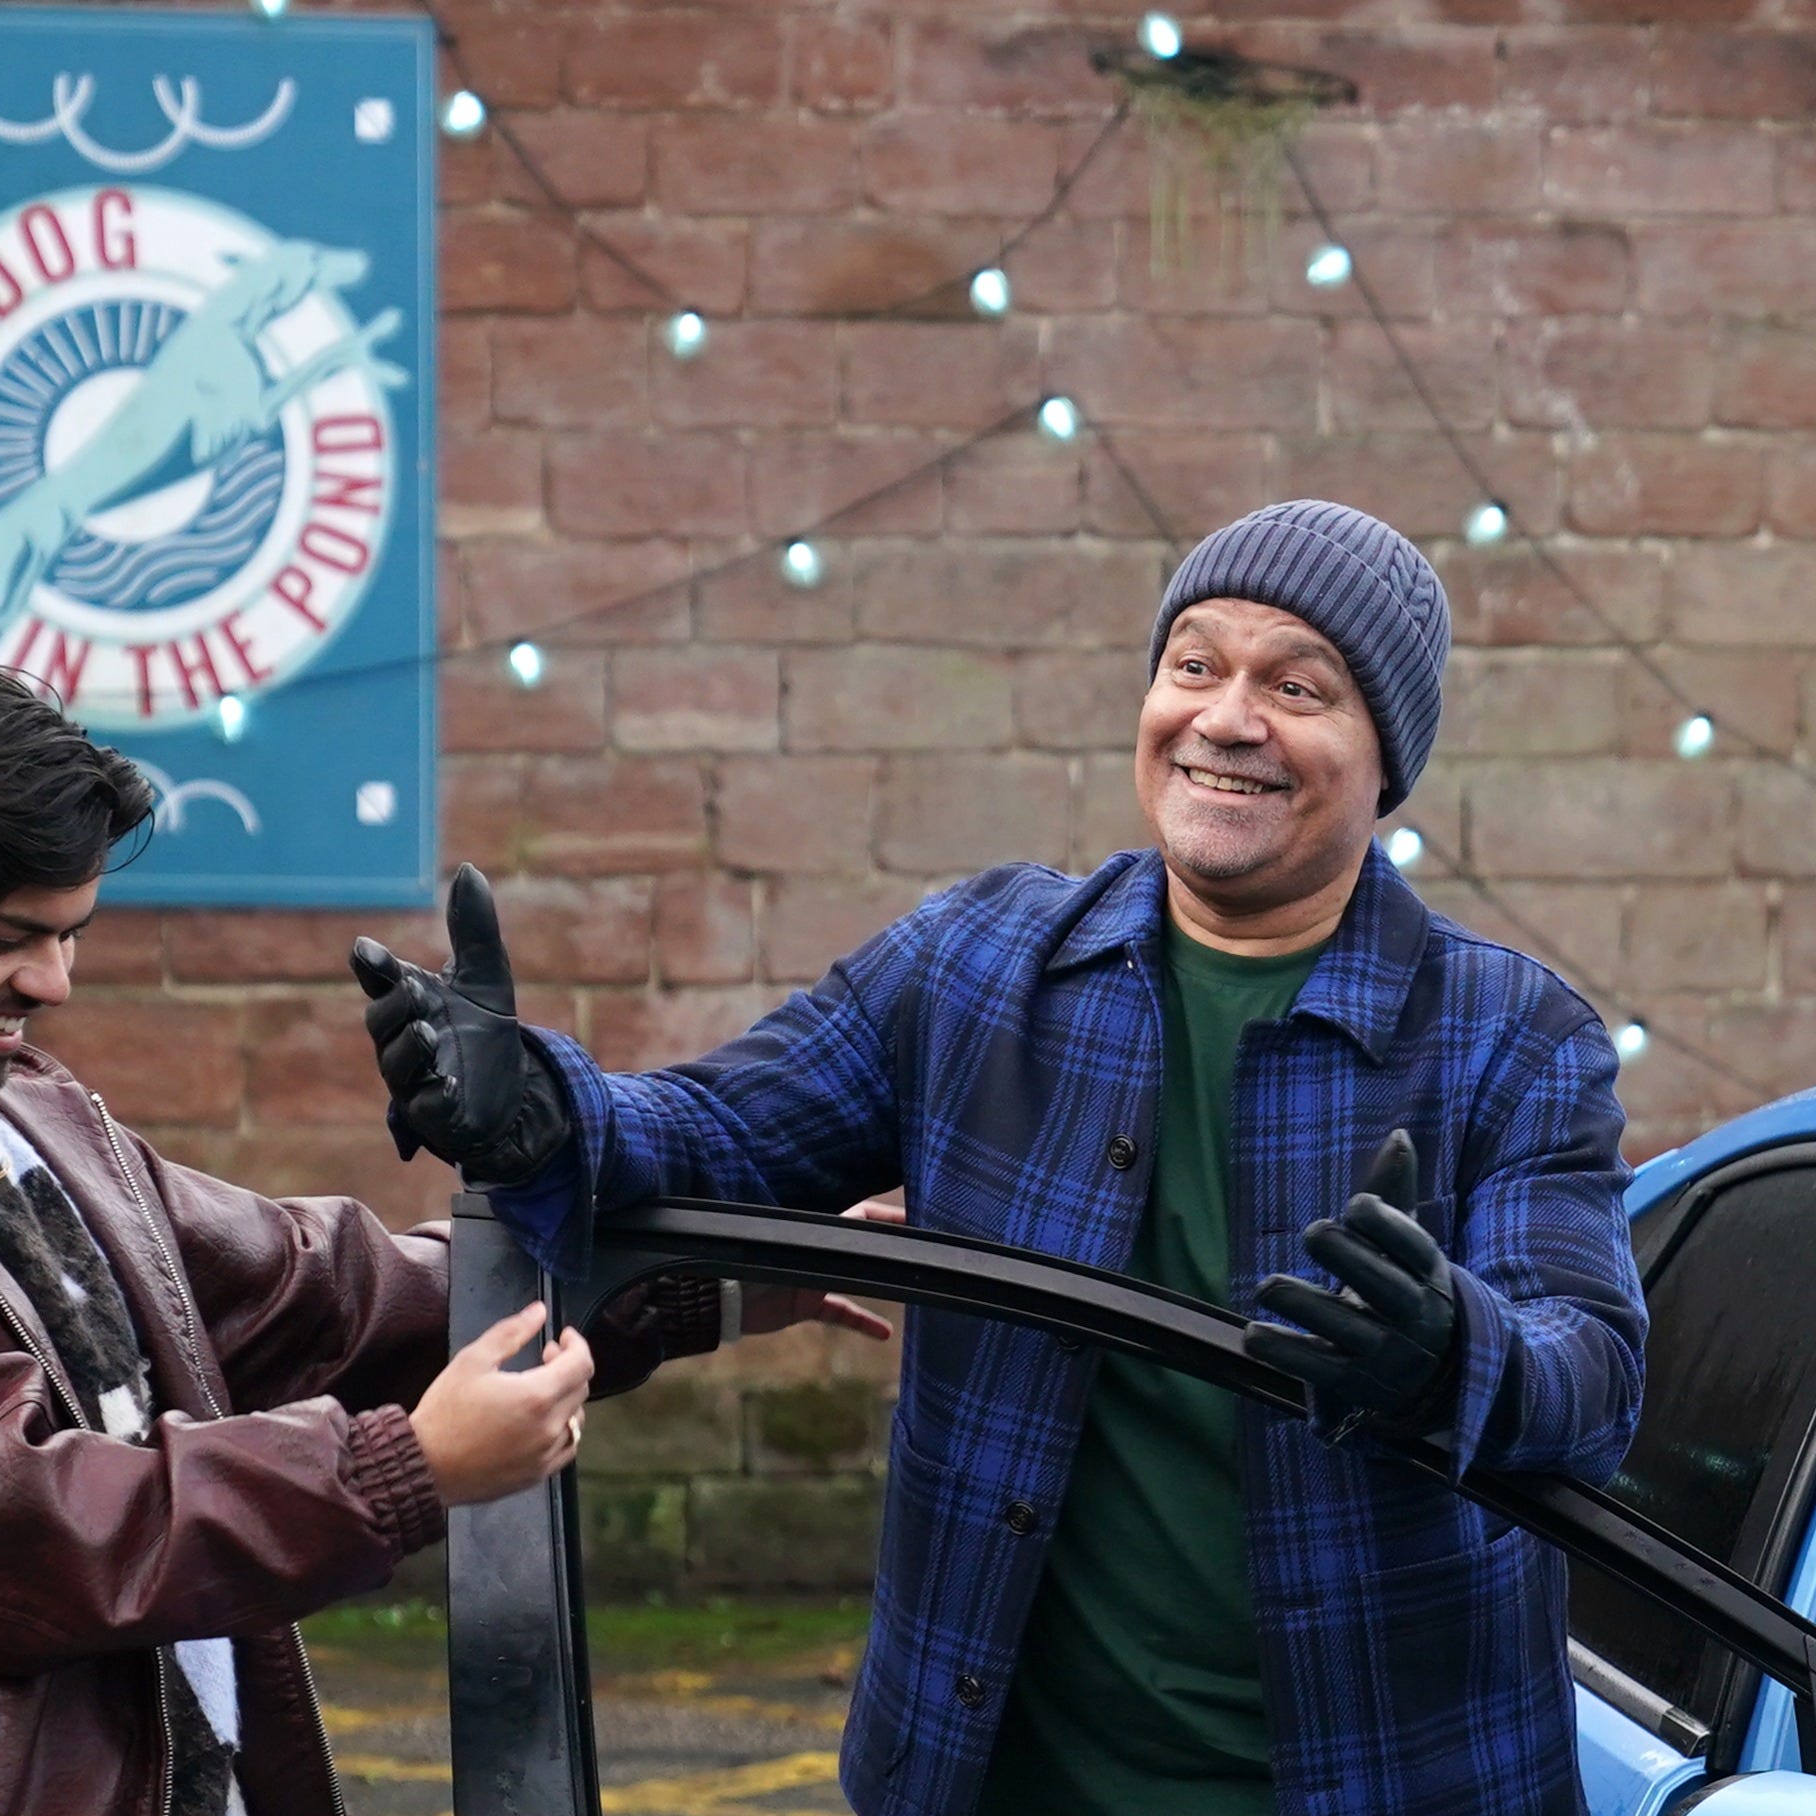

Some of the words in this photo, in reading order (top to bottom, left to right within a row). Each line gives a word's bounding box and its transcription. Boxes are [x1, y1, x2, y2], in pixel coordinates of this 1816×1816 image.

[6, 617, 92, 705] IN
[125, 611, 273, 717] THE
[269, 414, 384, 634] POND
